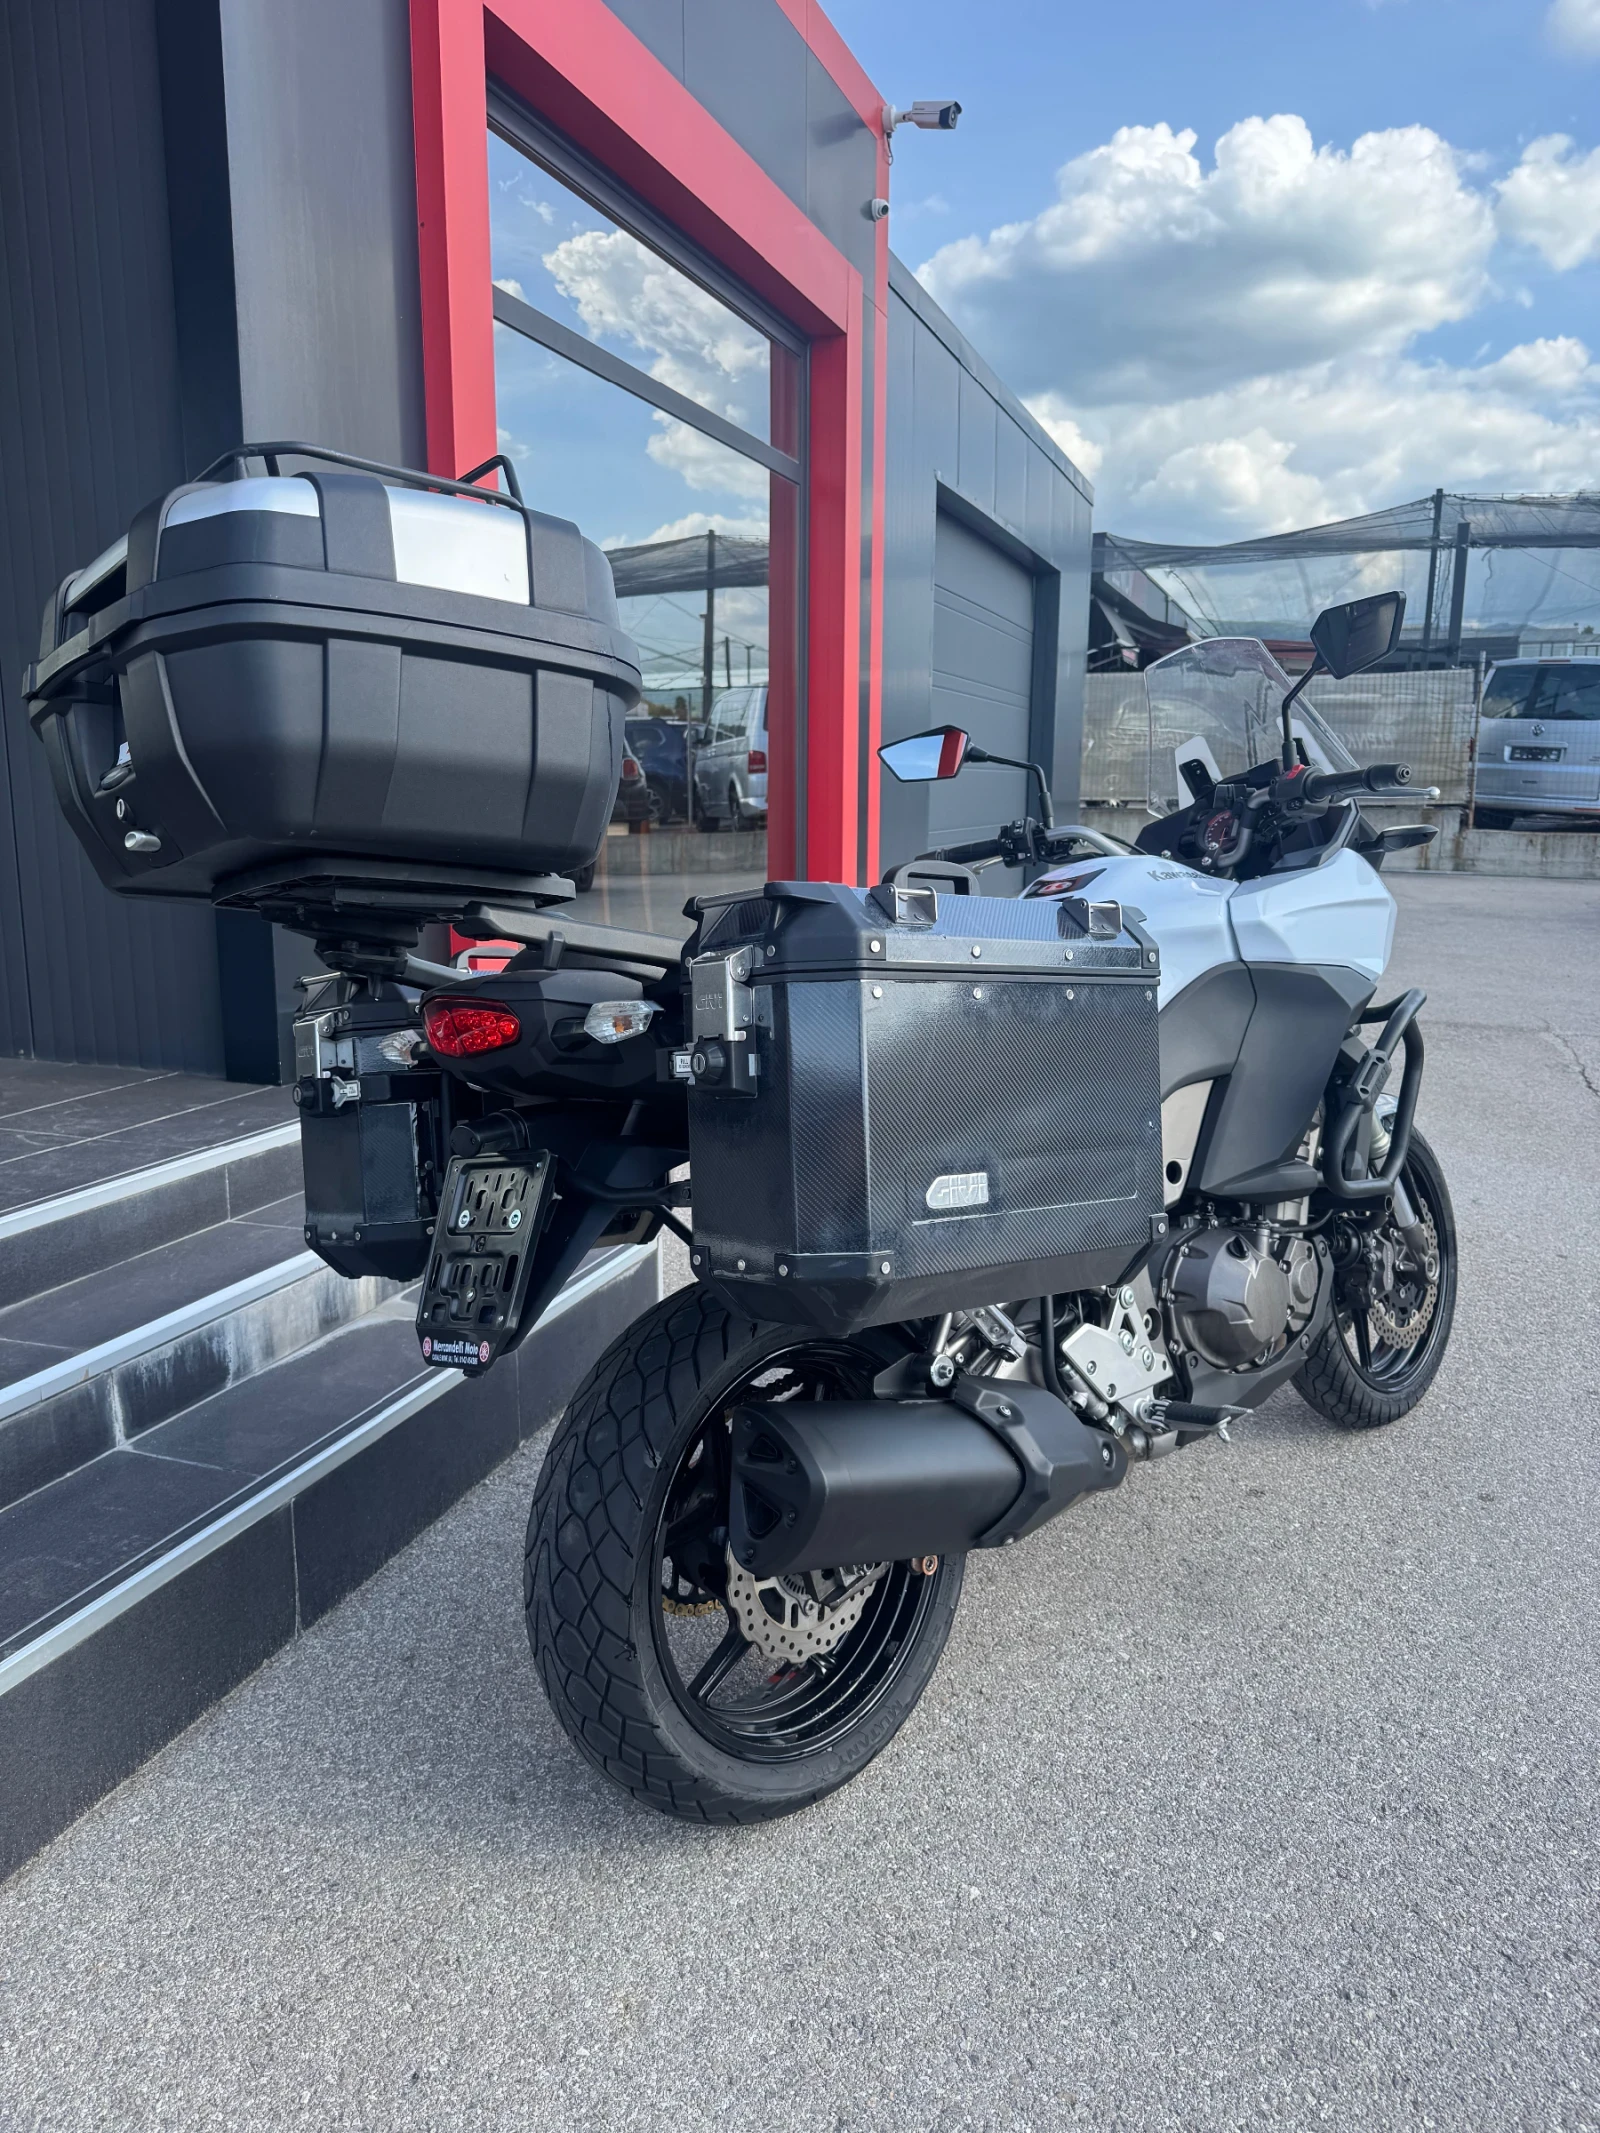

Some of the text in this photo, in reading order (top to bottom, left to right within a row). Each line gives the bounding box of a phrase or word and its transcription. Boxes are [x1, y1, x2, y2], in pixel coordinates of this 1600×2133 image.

[926, 1172, 989, 1209] GIVI
[433, 1339, 479, 1355] Mercandelli Moto
[840, 1700, 903, 1765] MUTANT
